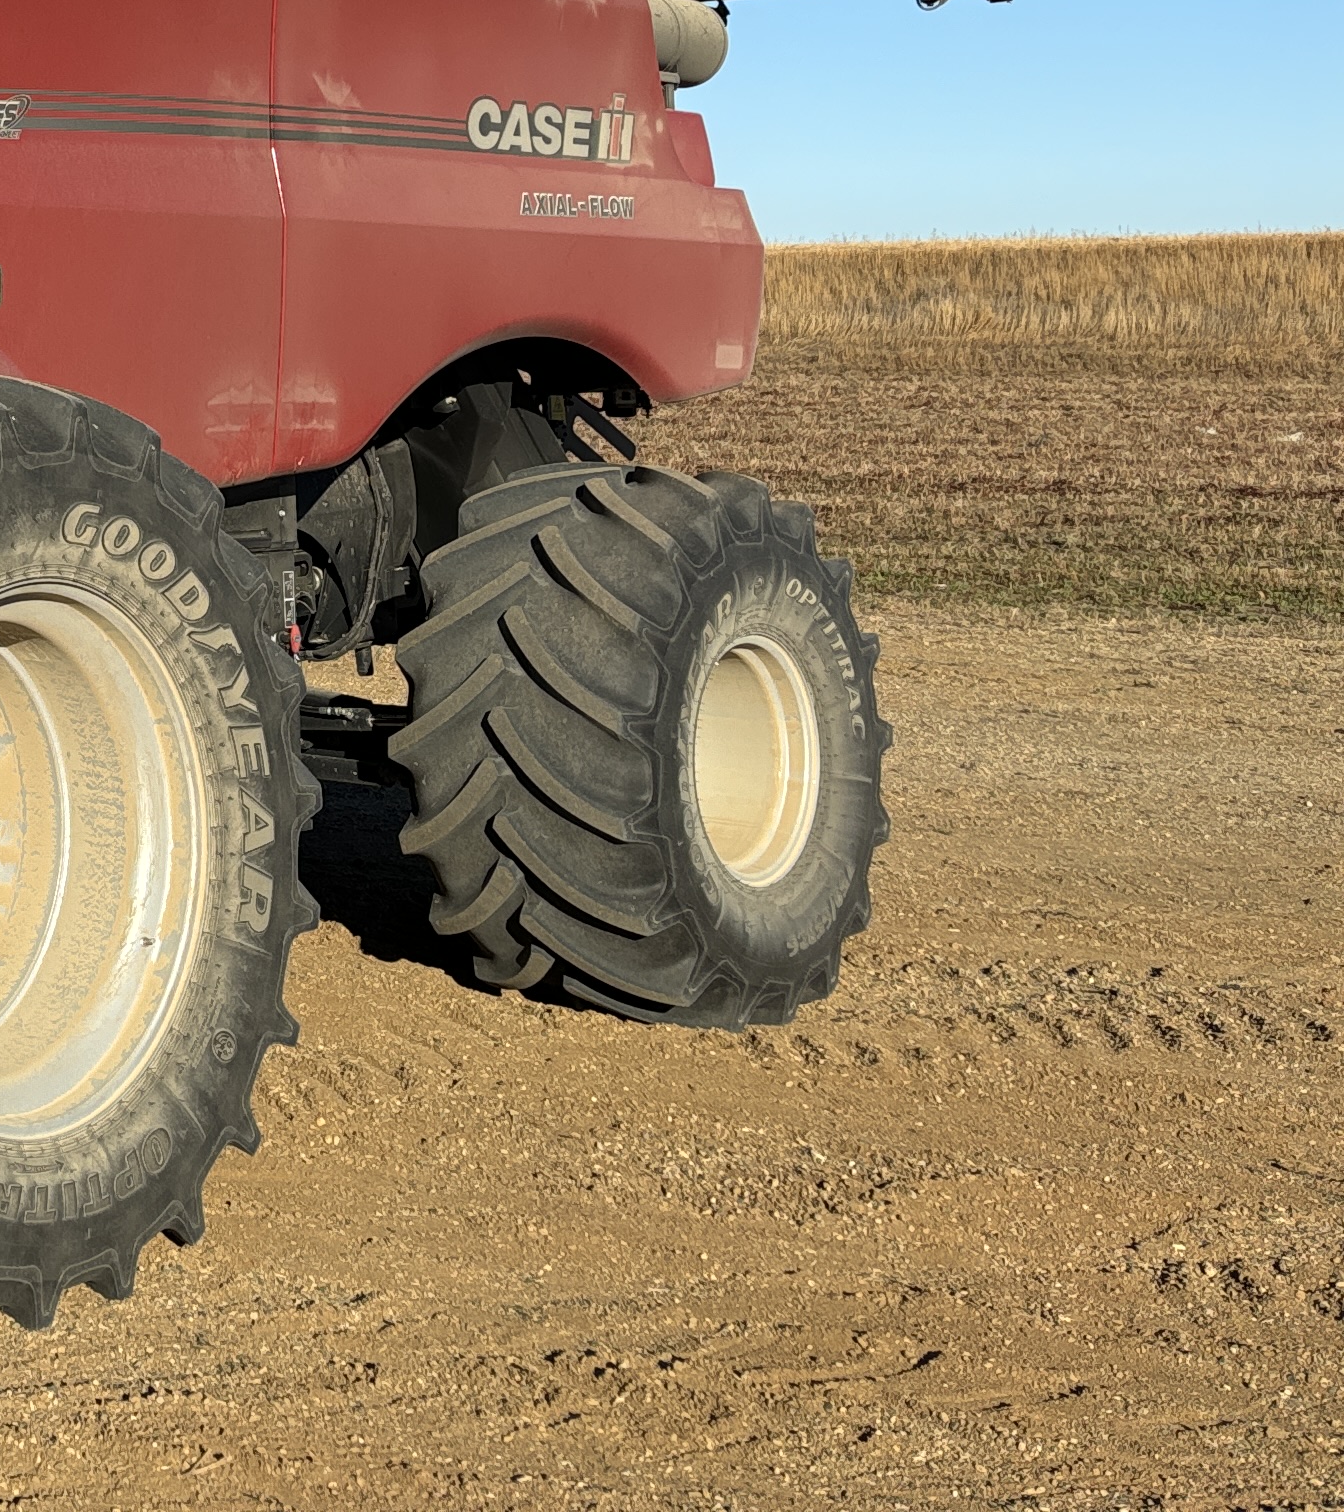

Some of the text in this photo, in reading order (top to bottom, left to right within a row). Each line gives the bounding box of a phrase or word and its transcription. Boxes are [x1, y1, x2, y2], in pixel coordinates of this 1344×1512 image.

[466, 96, 593, 159] CASE
[520, 191, 635, 220] AXIAL-FLOW
[785, 577, 867, 741] OPTITRAC
[61, 502, 275, 934] GOODYEAR
